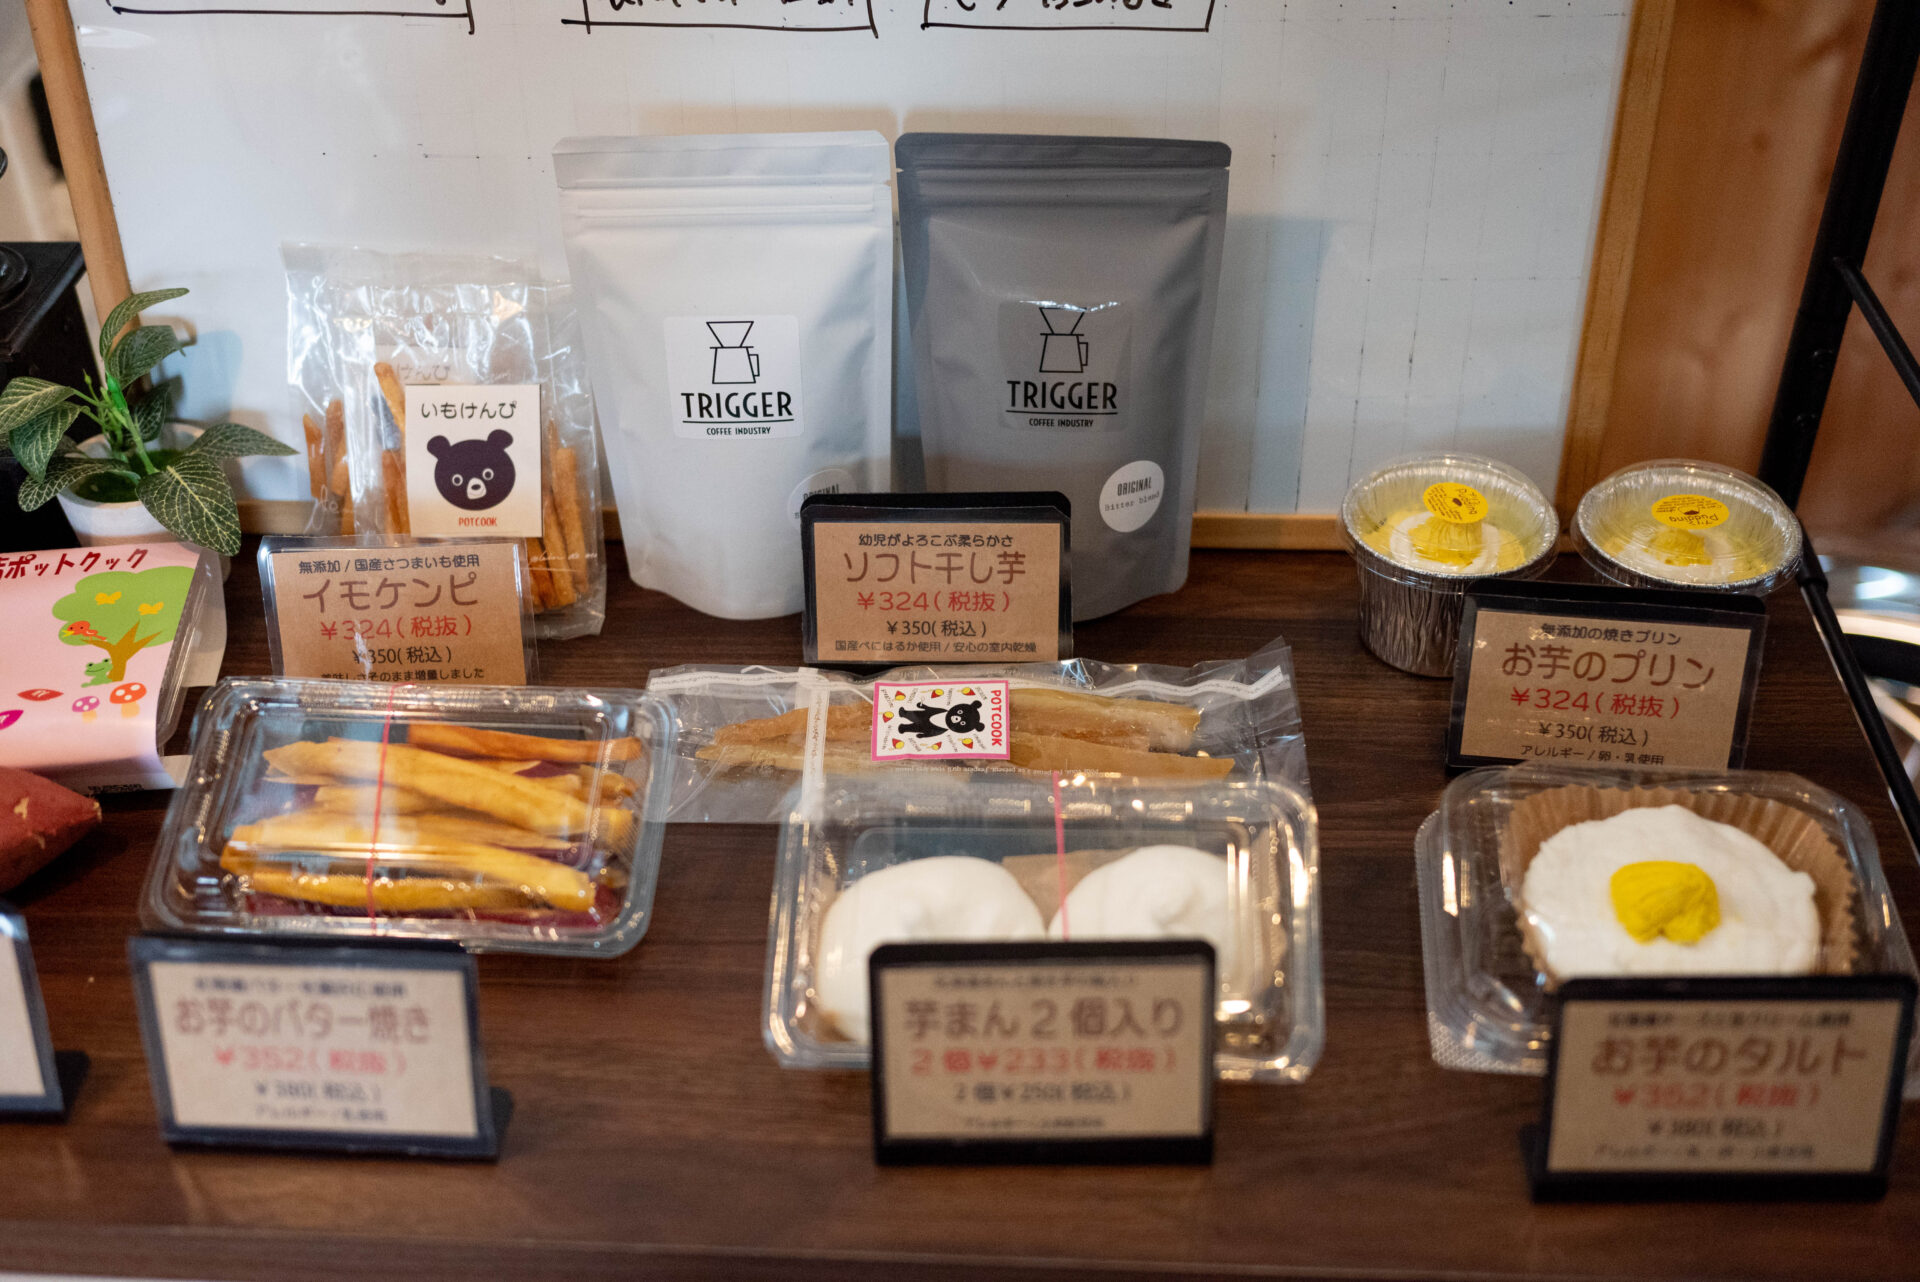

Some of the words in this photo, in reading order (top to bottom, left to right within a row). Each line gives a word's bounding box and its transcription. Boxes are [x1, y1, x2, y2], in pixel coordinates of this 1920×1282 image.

[680, 391, 793, 418] TRIGGER
[1006, 380, 1118, 410] TRIGGER
[421, 400, 518, 420] いもけんぴ
[1029, 418, 1055, 427] COFFEE
[1057, 418, 1094, 428] INDUSTRY
[706, 427, 732, 436] COFFEE
[735, 426, 772, 436] INDUSTRY
[1117, 476, 1153, 497] ORIGINAL
[458, 516, 498, 528] POTCOOK
[858, 533, 1014, 548] 幼児がよろこぶ柔らかさ
[843, 550, 1027, 585] ソフト干し芋
[302, 571, 480, 614] イモケンピ
[1501, 641, 1715, 690] お芋のプリン
[990, 689, 1003, 747] POTCOOK
[175, 998, 430, 1044] お芋のバター焼き
[1590, 1035, 1868, 1079] お芋のタルト
